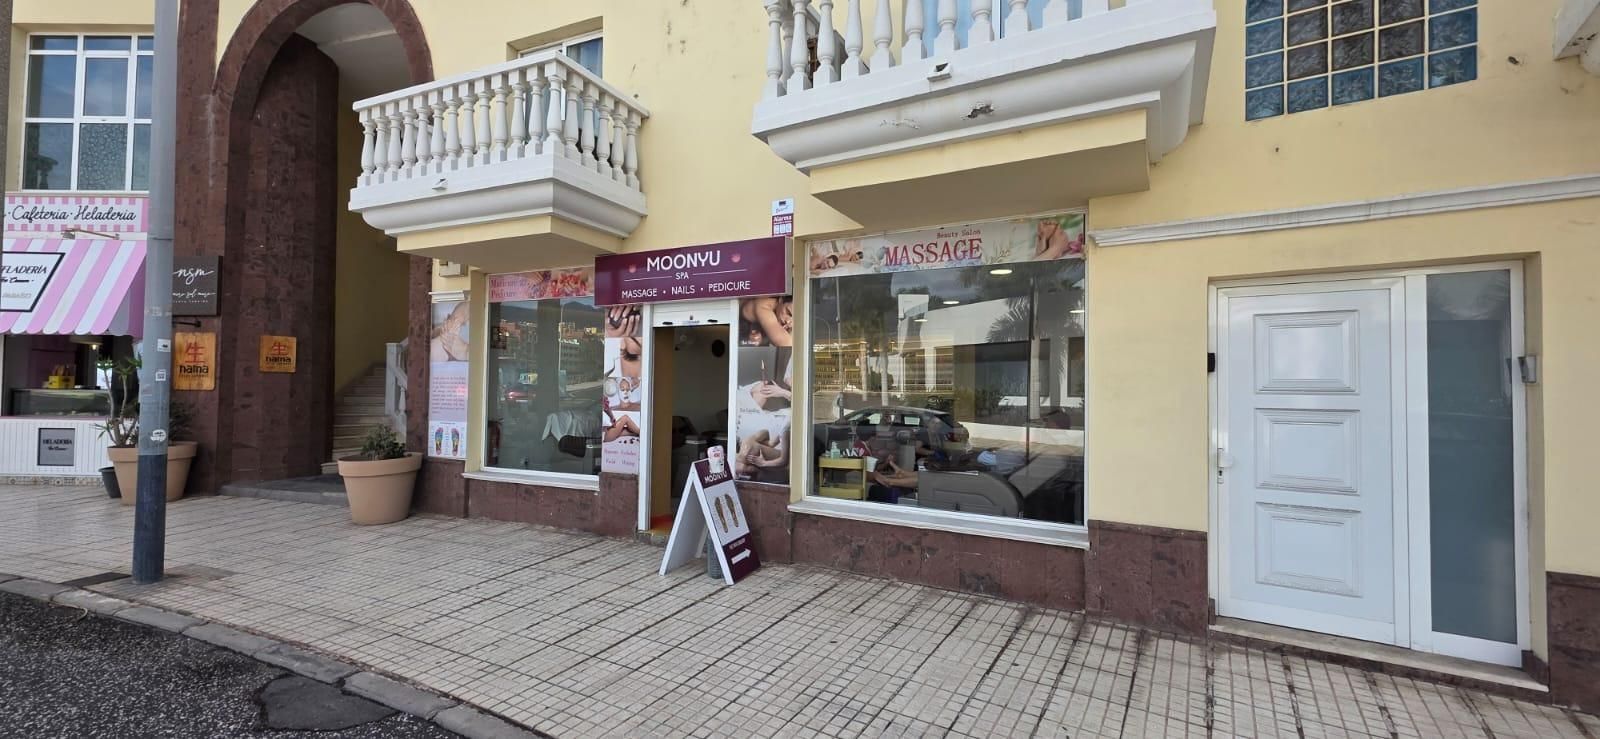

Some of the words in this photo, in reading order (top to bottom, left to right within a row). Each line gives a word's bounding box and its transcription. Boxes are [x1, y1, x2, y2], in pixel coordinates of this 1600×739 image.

[646, 250, 721, 272] MOONYU
[885, 238, 983, 266] MASSAGE
[675, 271, 689, 281] SPA
[621, 288, 658, 300] MASSAGE
[671, 285, 696, 296] NAILS
[708, 281, 751, 293] PEDICURE
[185, 341, 206, 364] 生
[704, 470, 728, 484] MOONYU
